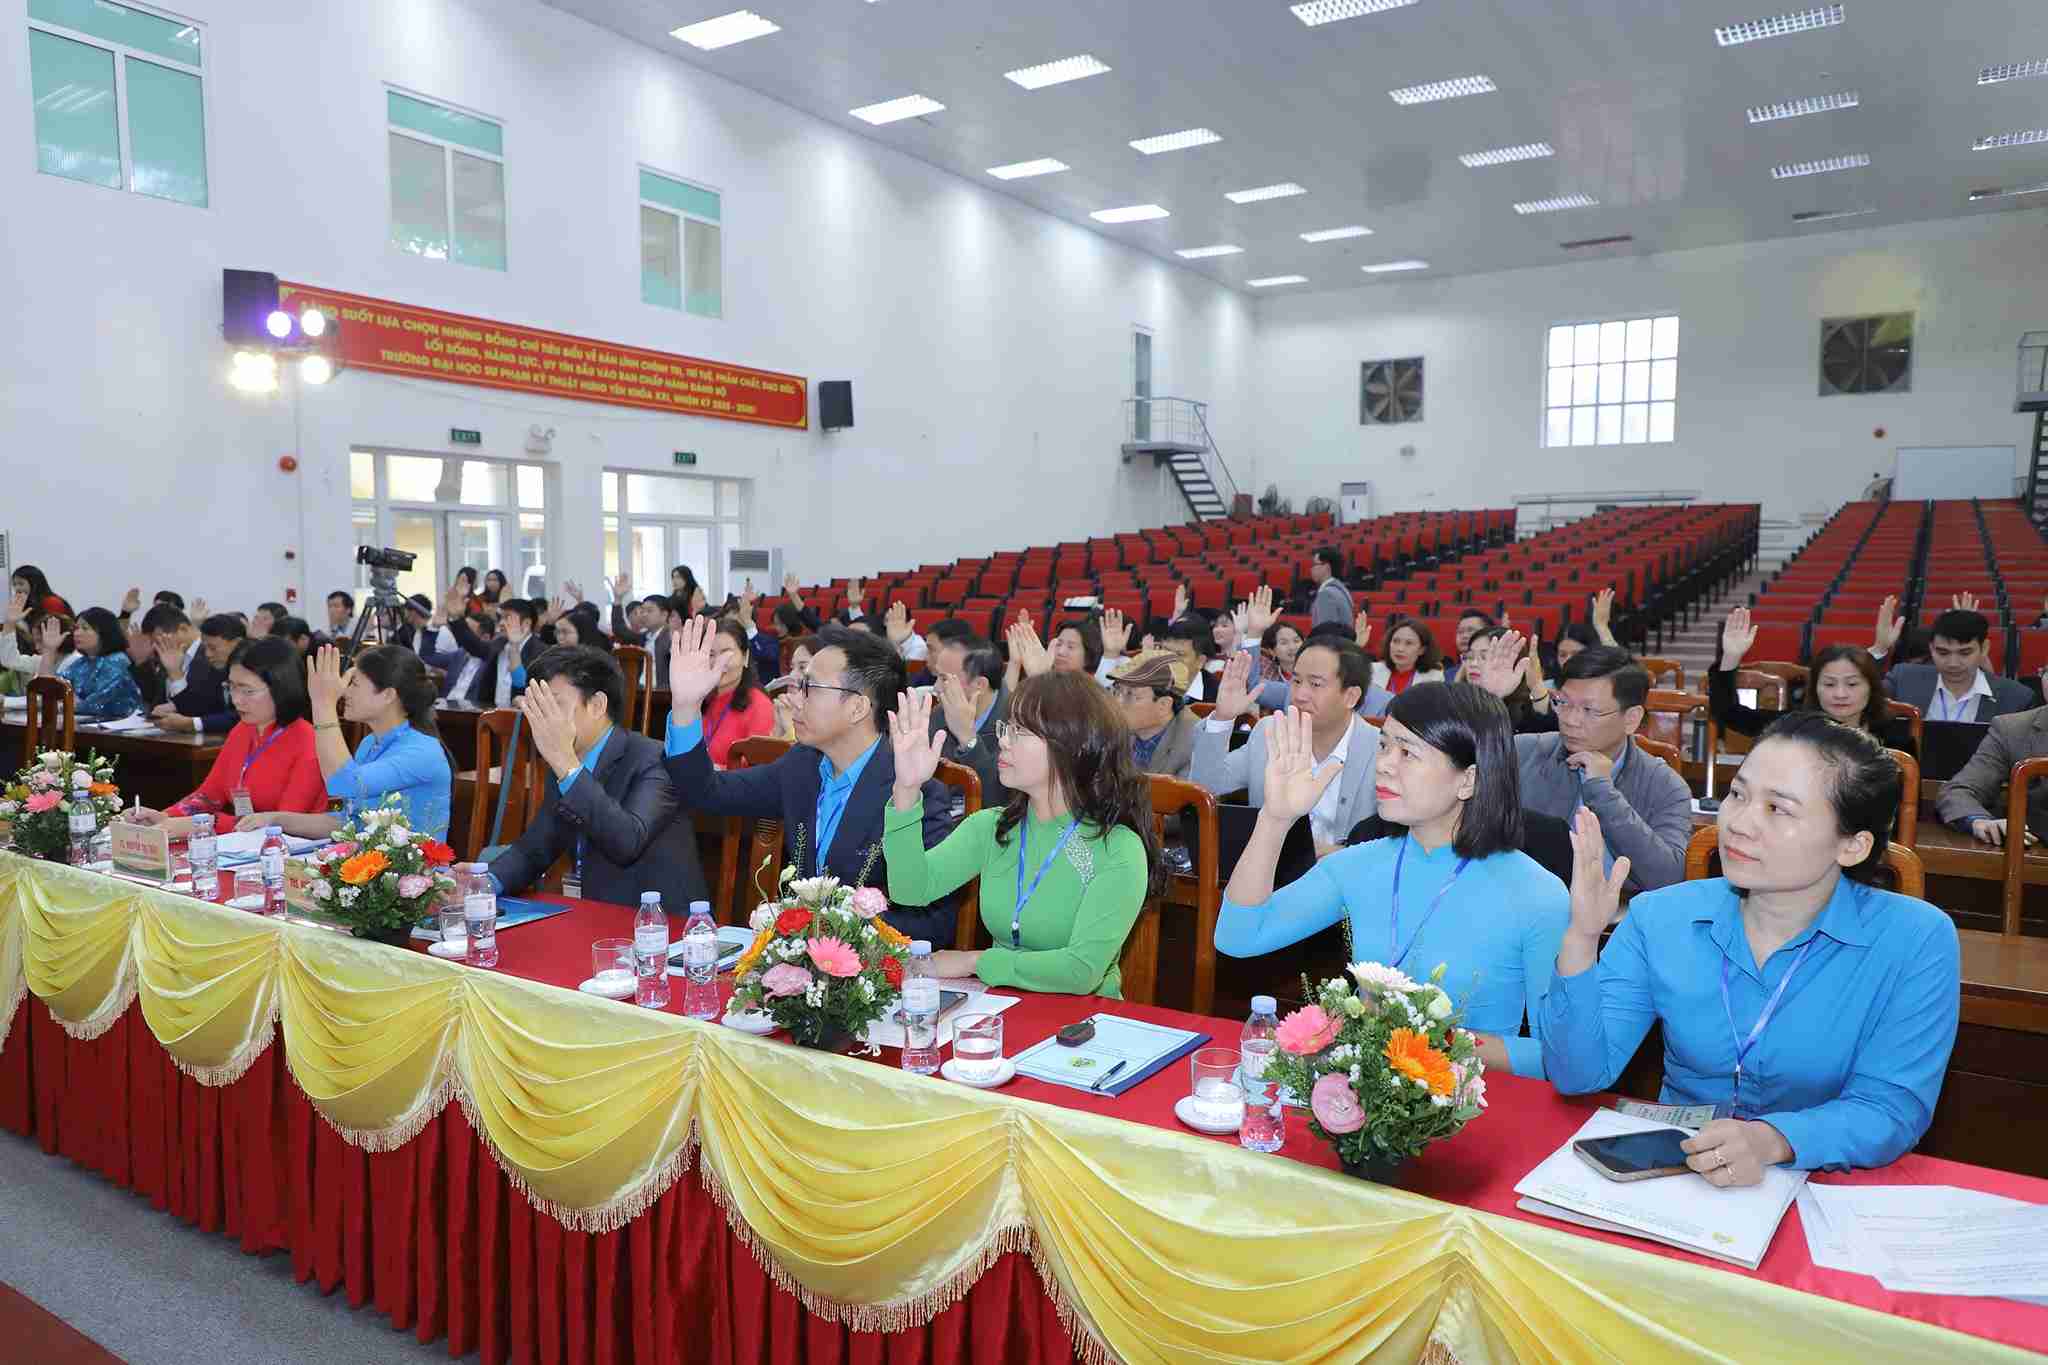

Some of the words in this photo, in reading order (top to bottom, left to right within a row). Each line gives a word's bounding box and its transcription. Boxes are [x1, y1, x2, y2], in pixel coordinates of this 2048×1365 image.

[341, 307, 375, 325] SUỐT
[376, 313, 400, 330] LỰA
[403, 319, 439, 336] CHỌN
[424, 338, 444, 353] LỐI
[380, 349, 430, 368] TRƯỜNG
[431, 358, 453, 372] ĐẠI
[454, 361, 481, 376] HỌC
